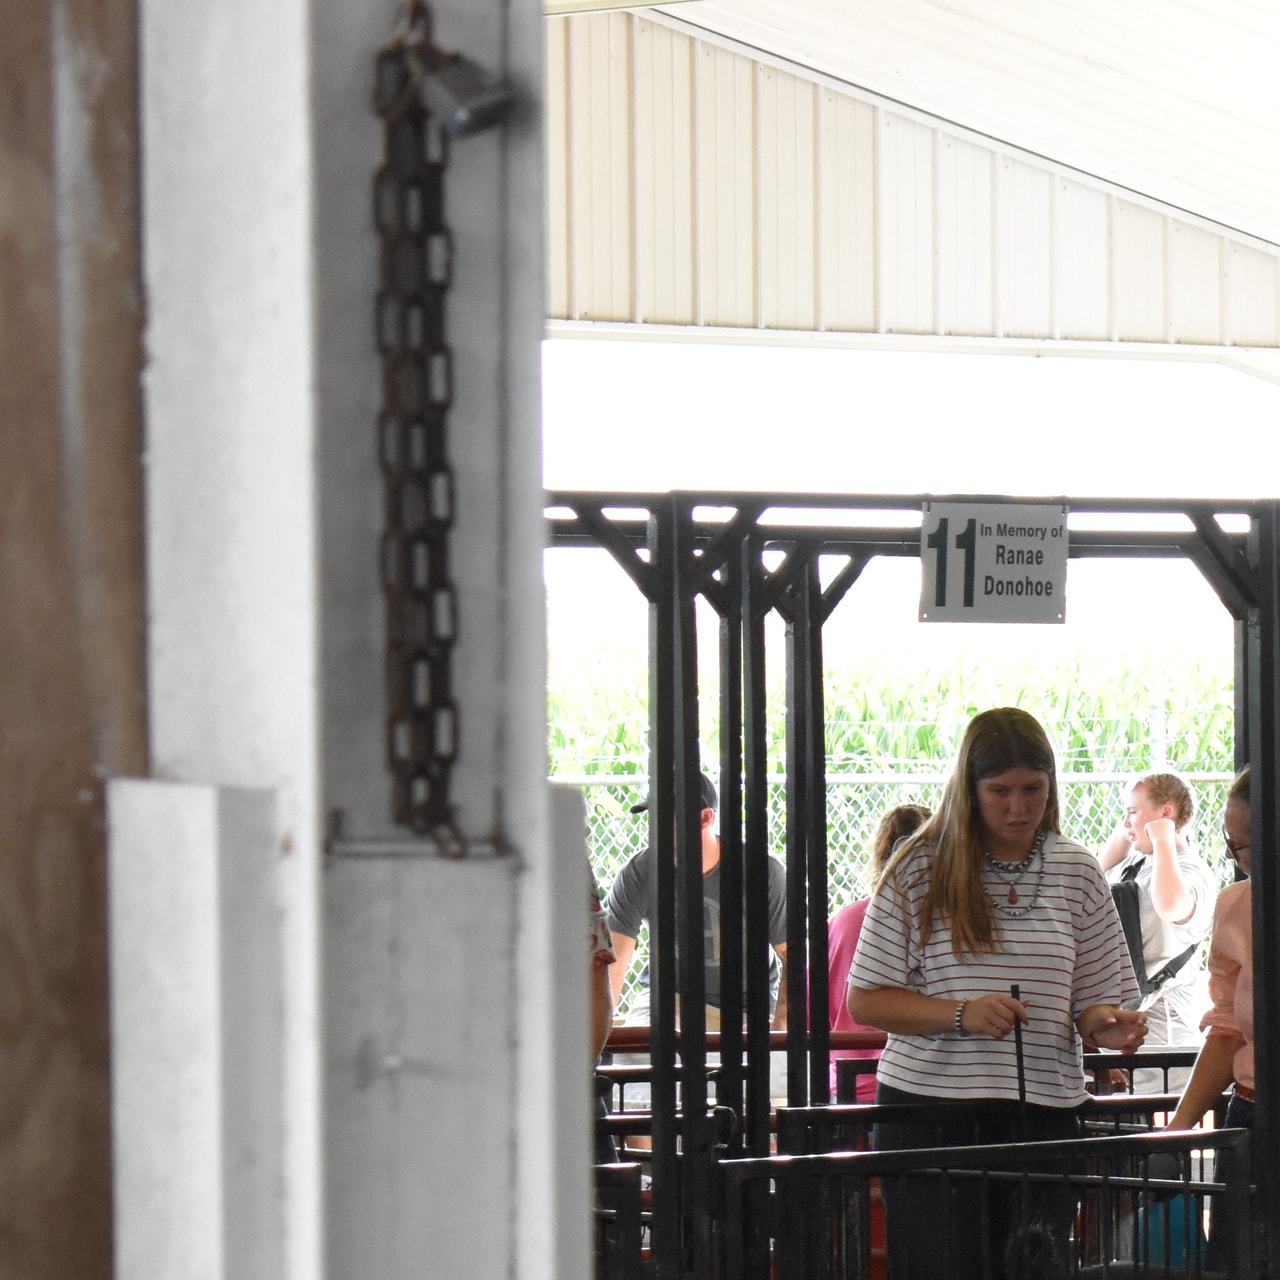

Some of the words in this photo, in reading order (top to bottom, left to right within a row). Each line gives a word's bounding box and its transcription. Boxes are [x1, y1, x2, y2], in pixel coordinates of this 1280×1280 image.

[980, 523, 992, 537] In
[996, 523, 1047, 541] Memory
[1051, 524, 1063, 538] of
[927, 517, 977, 607] 11
[995, 544, 1044, 565] Ranae
[983, 575, 1053, 596] Donohoe
